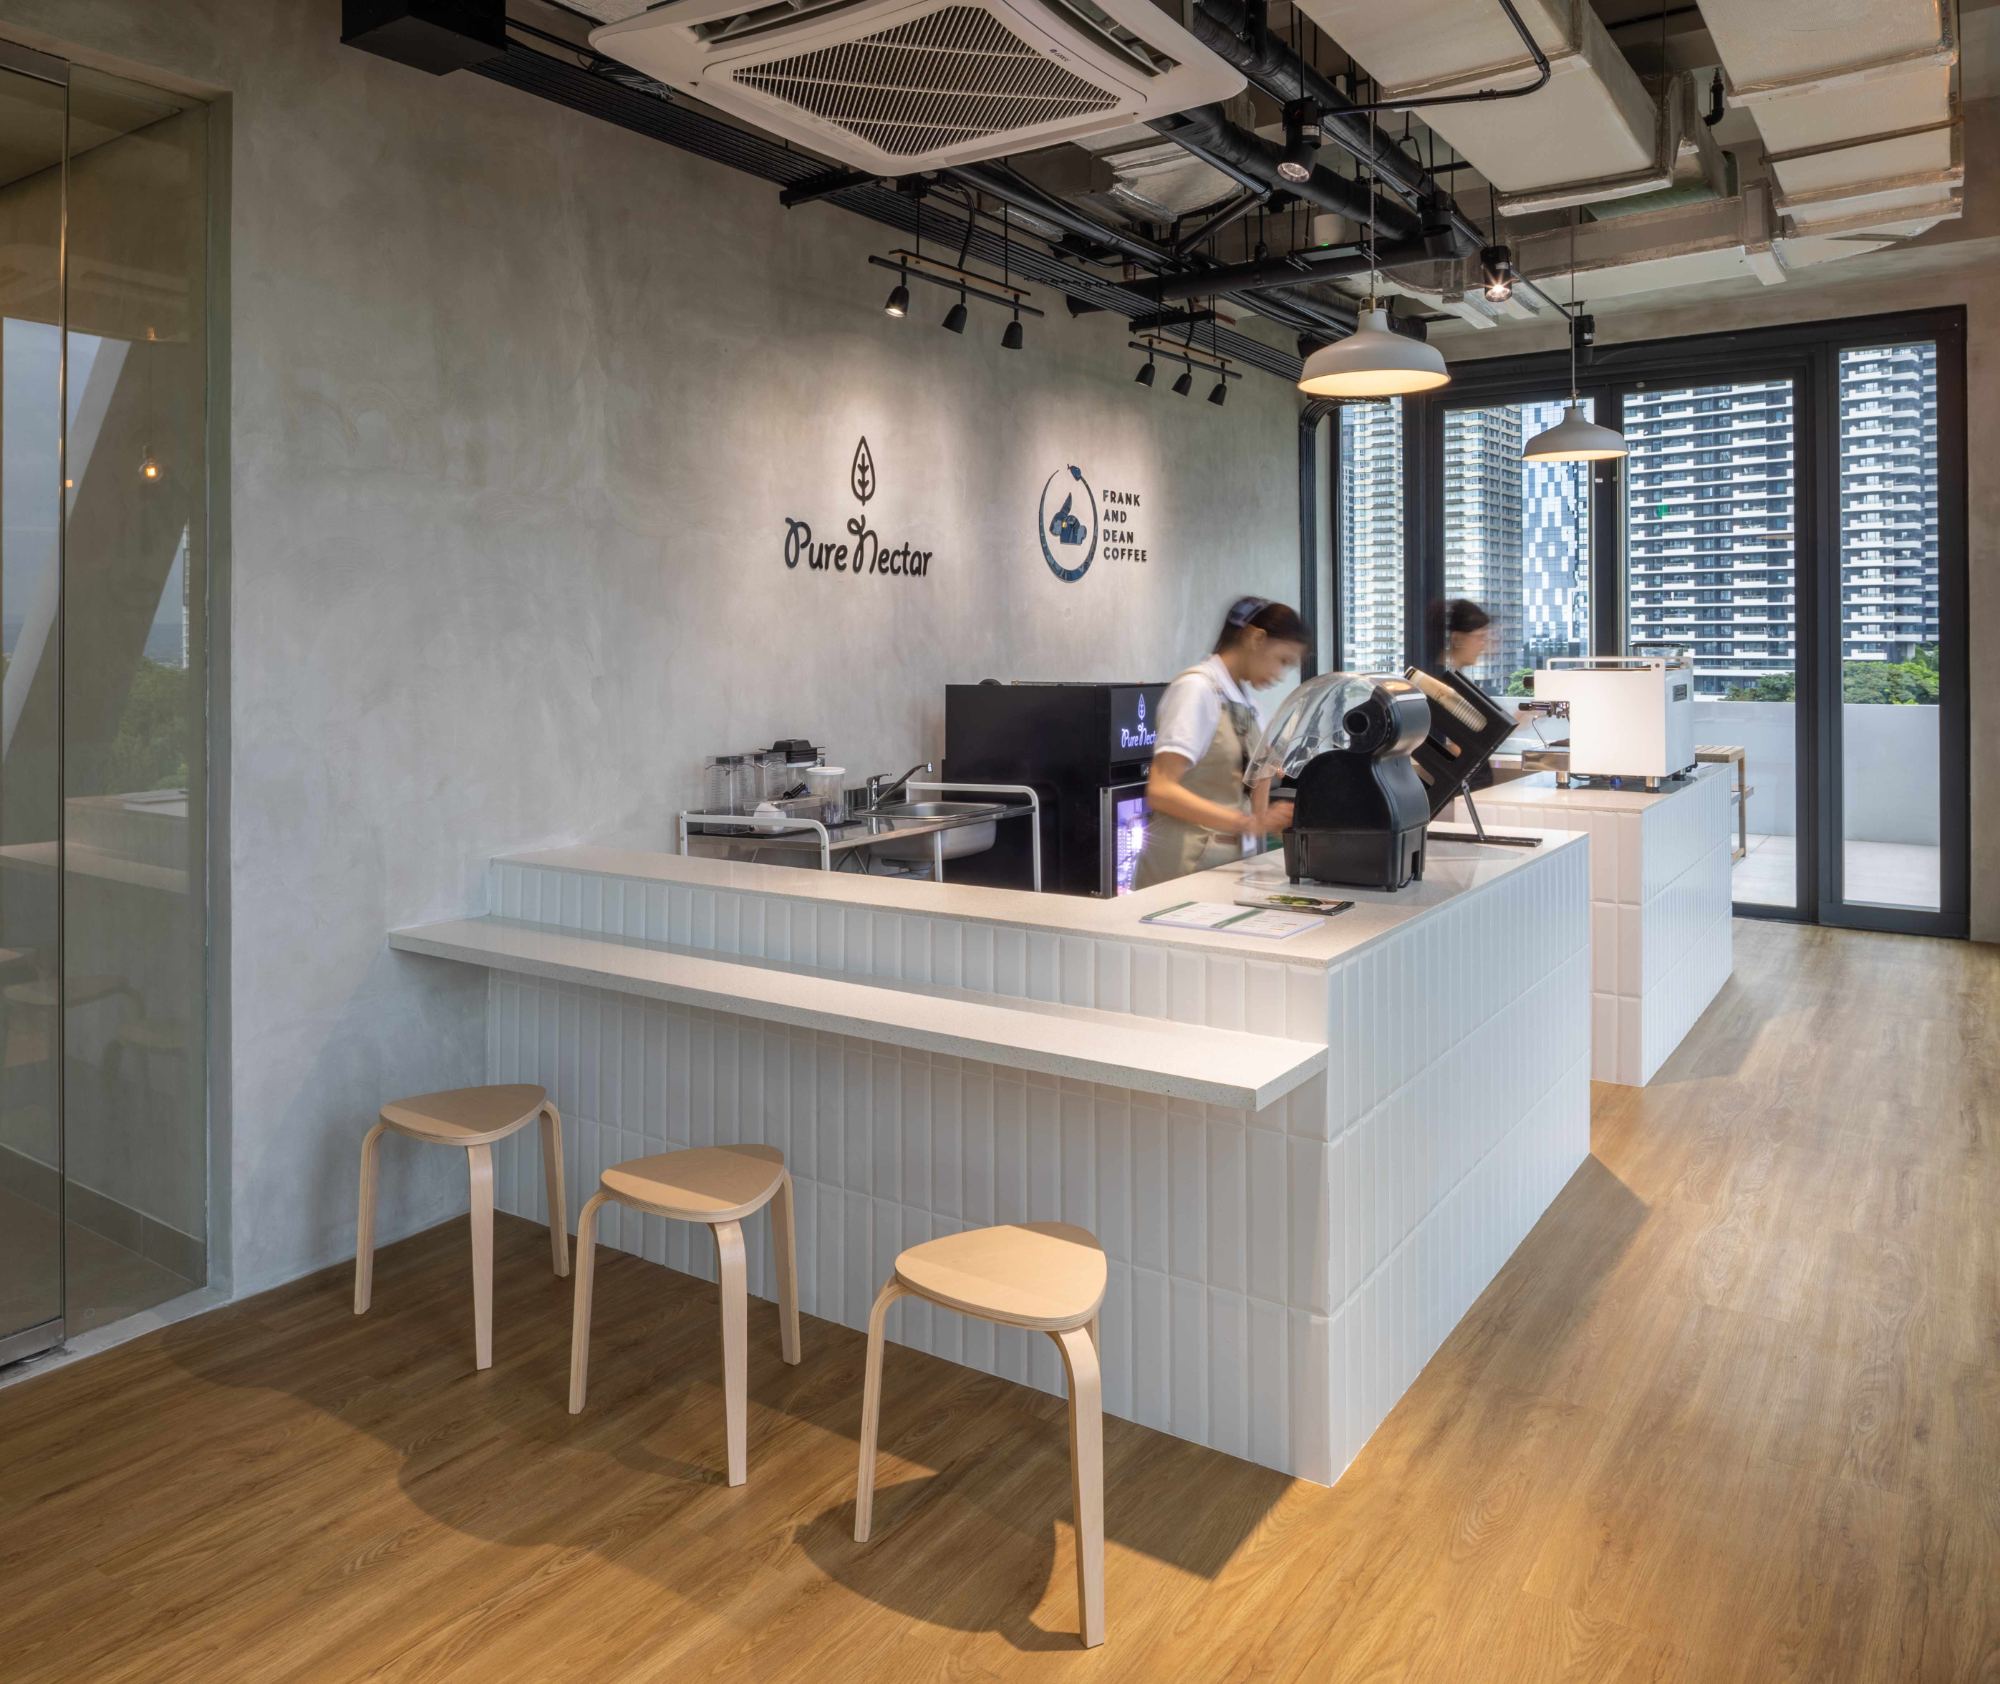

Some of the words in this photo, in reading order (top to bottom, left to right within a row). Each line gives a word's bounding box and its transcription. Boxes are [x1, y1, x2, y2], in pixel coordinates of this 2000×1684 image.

[1103, 490, 1140, 507] FRANK
[1104, 509, 1127, 523] AND
[1103, 529, 1133, 544] DEAN
[785, 517, 848, 570] Pure
[847, 514, 933, 576] Nectar
[1104, 547, 1147, 562] COFFEE
[1121, 728, 1138, 748] Pure
[1137, 722, 1157, 746] Nect
